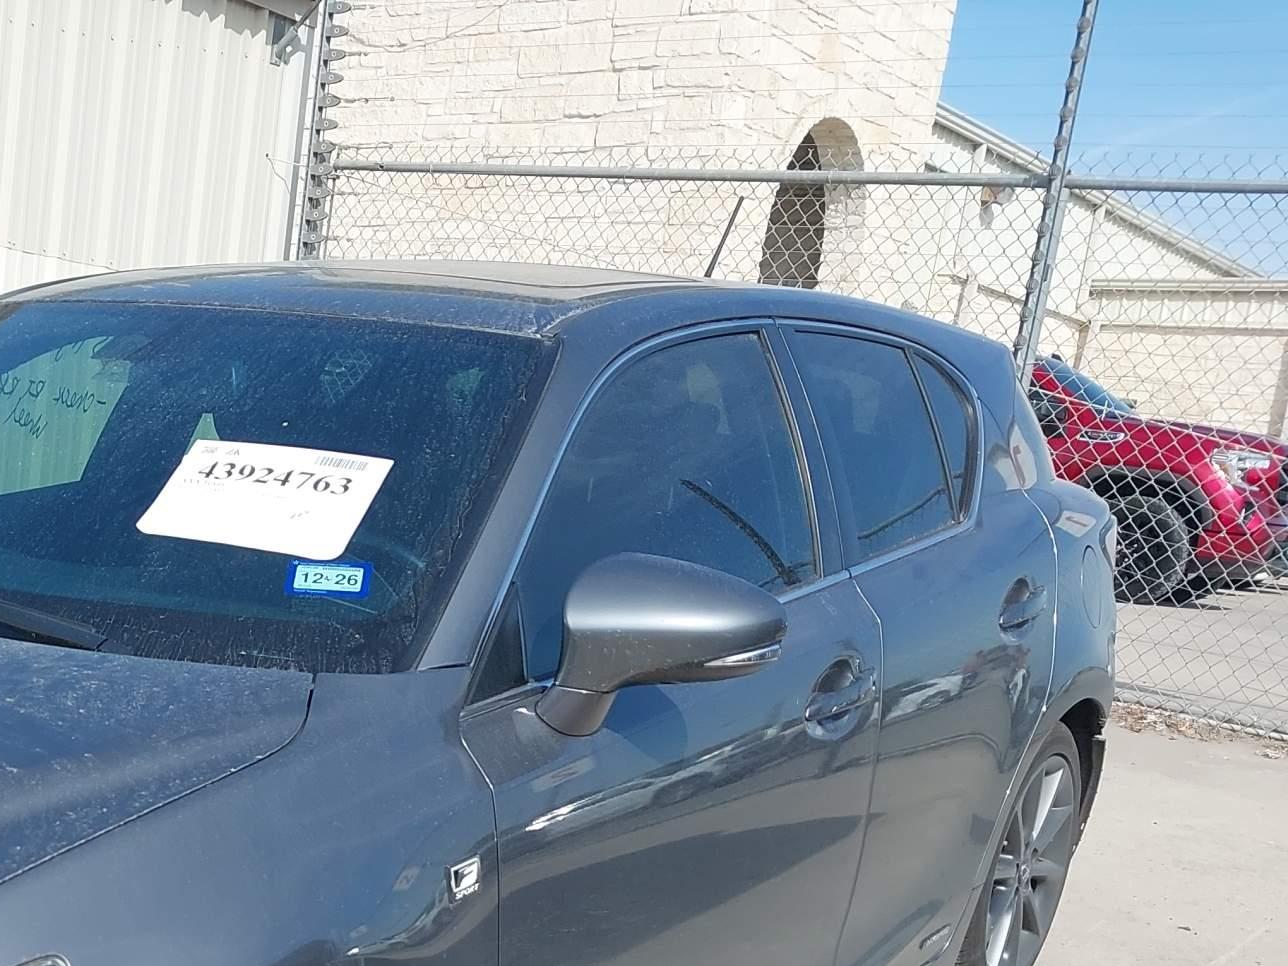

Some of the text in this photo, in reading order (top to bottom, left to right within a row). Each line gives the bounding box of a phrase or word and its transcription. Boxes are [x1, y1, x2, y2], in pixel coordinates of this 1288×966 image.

[197, 460, 353, 495] 43924763
[300, 571, 359, 587] 12 26
